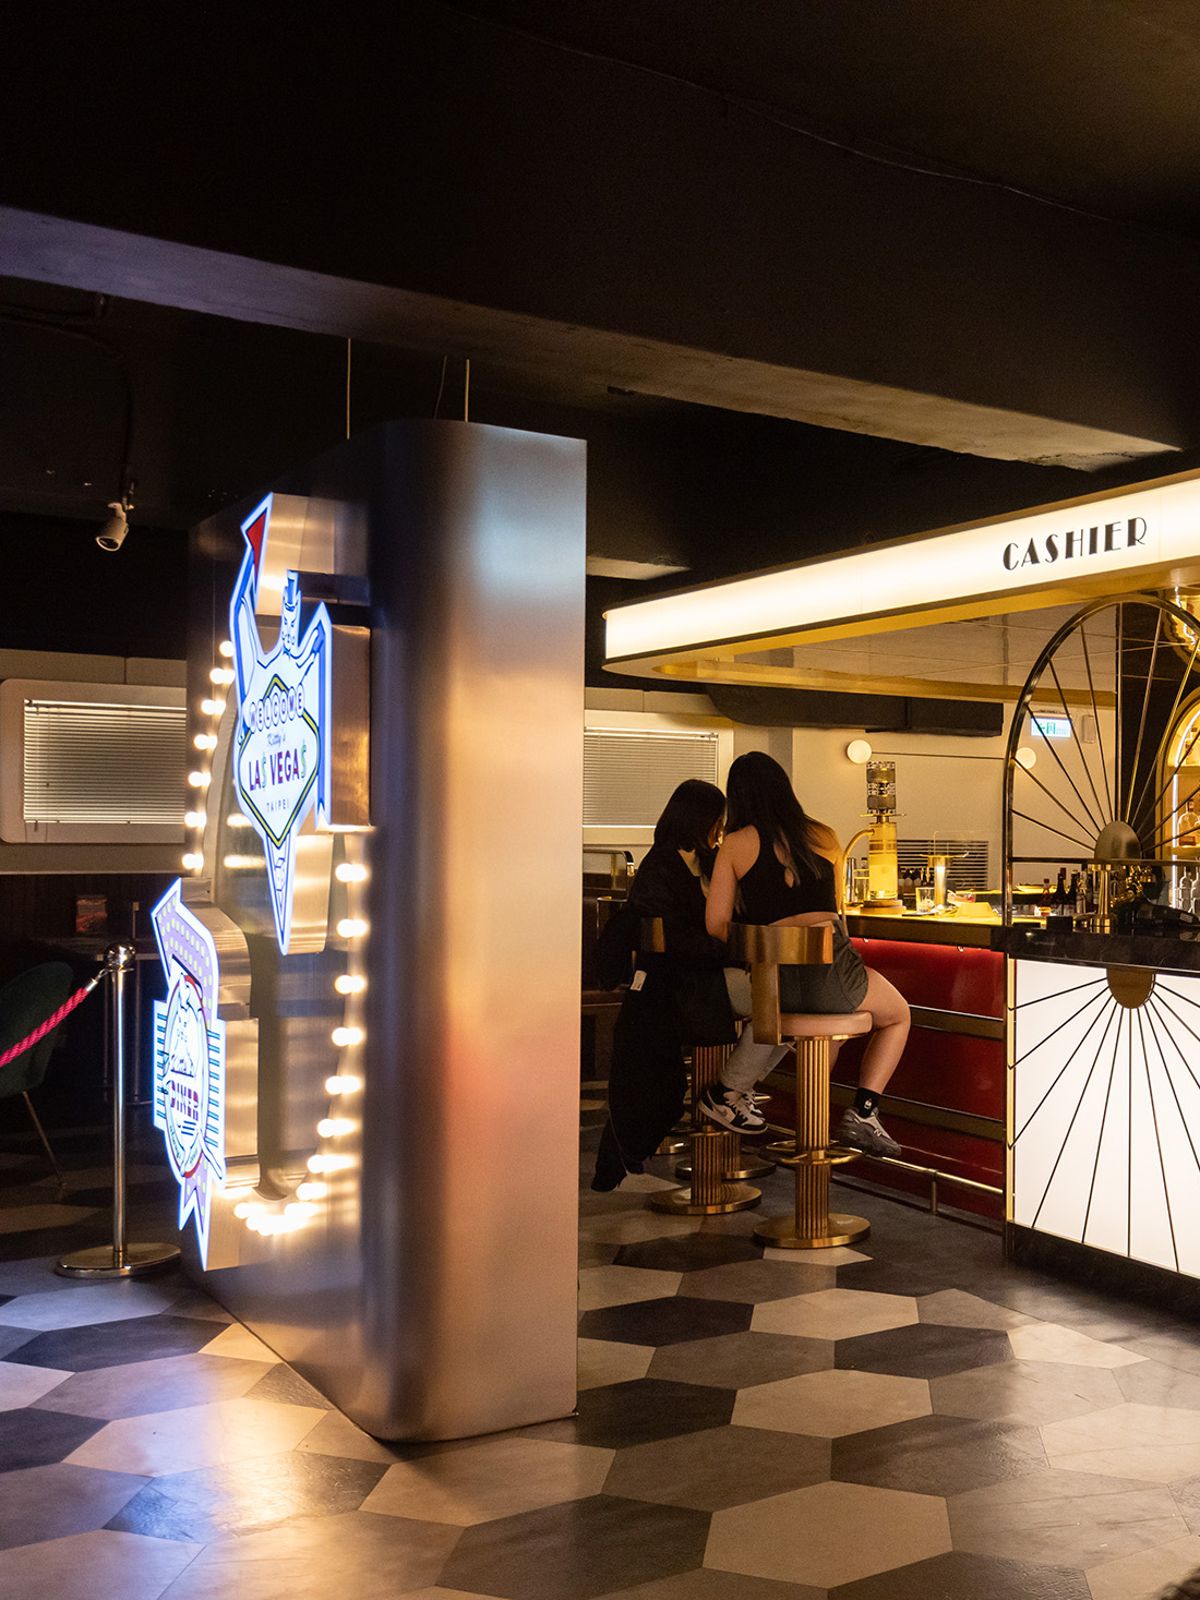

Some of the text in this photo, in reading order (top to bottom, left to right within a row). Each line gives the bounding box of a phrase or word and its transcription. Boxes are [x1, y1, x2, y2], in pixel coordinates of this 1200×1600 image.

[1002, 516, 1148, 571] CASHIER
[249, 690, 304, 728] WELCOME
[266, 799, 290, 813] TAIPEI
[170, 1080, 199, 1121] DINER
